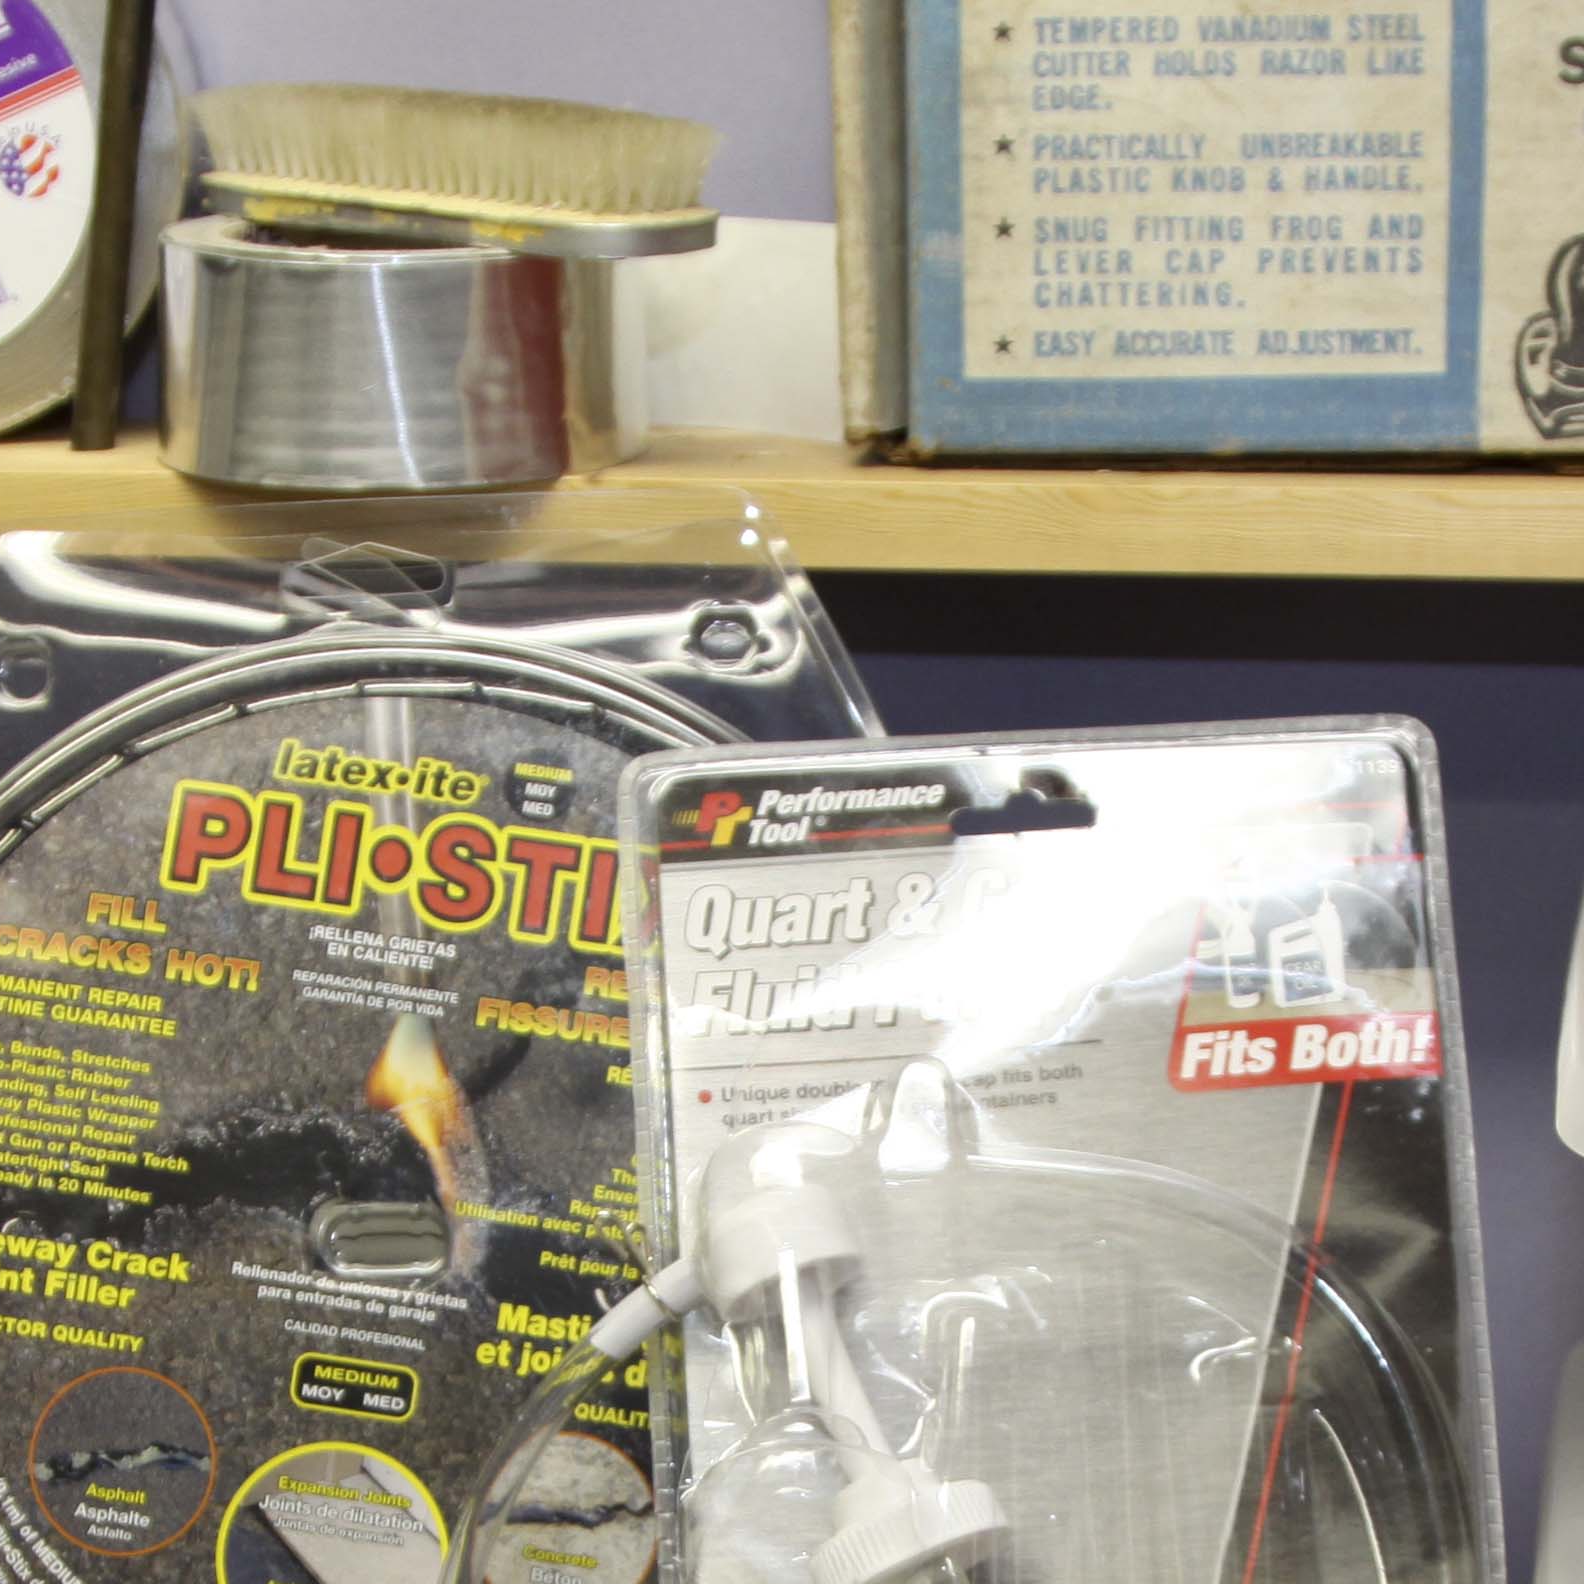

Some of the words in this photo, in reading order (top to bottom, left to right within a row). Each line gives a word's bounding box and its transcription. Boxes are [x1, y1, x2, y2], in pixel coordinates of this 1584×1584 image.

[1033, 15, 1180, 46] TEMPERED
[1197, 14, 1332, 45] VANADIUM
[1346, 13, 1426, 44] STEEL
[1031, 49, 1132, 79] CUTTER
[1152, 48, 1237, 78] HOLDS
[1259, 48, 1346, 78] RAZOR
[1366, 47, 1426, 77] LIKE
[1031, 82, 1114, 112] EDGE.
[1031, 132, 1207, 163] PRACTICALLY
[1241, 130, 1425, 161] UNBREAKABLE
[1031, 165, 1152, 196] PLASTIC
[1170, 164, 1246, 194] KNOB
[1267, 164, 1286, 193] &
[1032, 214, 1109, 245] SNUG
[1134, 214, 1245, 244] FITTING
[1269, 214, 1343, 243] FROG
[1367, 213, 1424, 242] AND
[1031, 247, 1135, 276] LEVER
[1164, 247, 1226, 275] CAP
[1257, 247, 1425, 275] PREVENTS
[1031, 279, 1247, 309] CHATTERING.
[1032, 330, 1095, 359] EASY
[1114, 329, 1234, 358] ACCURATE
[1256, 328, 1423, 357] ADJUSTMENT.
[514, 762, 573, 782] MEDIUM
[524, 782, 557, 798] MOY
[755, 783, 946, 816] Performance
[521, 800, 554, 818] MED
[747, 818, 810, 846] Tool
[85, 891, 169, 934] FILL
[684, 876, 873, 961] Quart
[886, 871, 939, 936] &
[327, 940, 350, 957] EN
[352, 944, 435, 971] CALIENTE!
[388, 936, 457, 959] GRIETAS
[165, 947, 263, 992] HOT!
[88, 987, 163, 1013] REPAIR
[373, 995, 389, 1009] DE
[389, 997, 413, 1013] POR
[415, 1001, 445, 1019] VIDA
[374, 980, 460, 1006] PERMANENTE
[51, 1004, 177, 1038] GUARANTEE
[72, 1050, 151, 1074] Stretches
[1179, 1029, 1279, 1081] Fits
[1289, 1018, 1434, 1072] Both!
[72, 1067, 133, 1090] Rubber
[54, 1084, 87, 1103] Self
[90, 1087, 161, 1114] Leveling
[82, 1125, 136, 1147] Repair
[86, 1240, 191, 1283] Crack
[43, 1270, 136, 1309] Filler
[52, 1322, 145, 1354] QUALITY
[284, 1318, 339, 1339] CALIDAD
[340, 1325, 427, 1351] PROFESIONAL
[312, 1364, 400, 1392] MEDIUM
[301, 1382, 345, 1403] MOY
[362, 1392, 405, 1412] MED
[84, 1482, 147, 1506] Asphalt
[74, 1501, 151, 1528] Asphalte
[258, 1494, 312, 1518] Joints
[316, 1503, 339, 1519] de
[343, 1507, 425, 1534] dilatation
[87, 1524, 133, 1542] Asfalto
